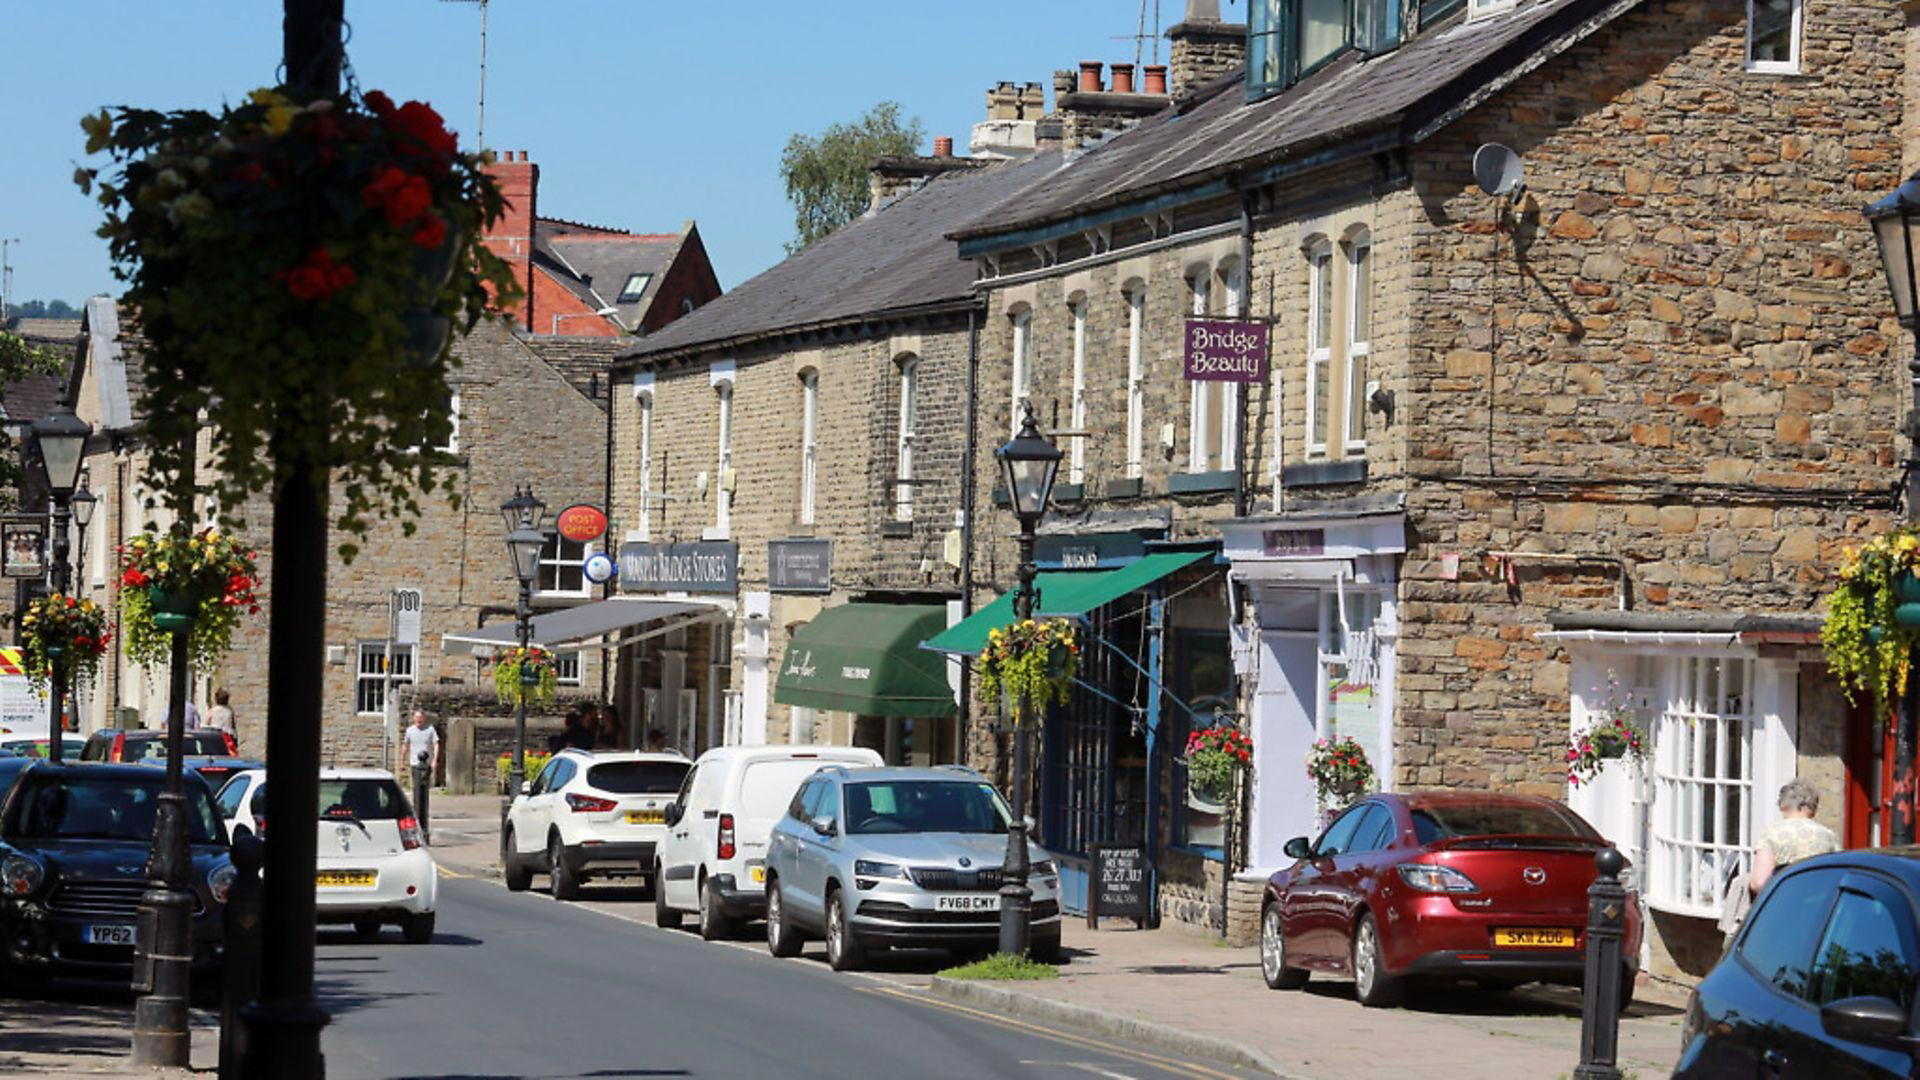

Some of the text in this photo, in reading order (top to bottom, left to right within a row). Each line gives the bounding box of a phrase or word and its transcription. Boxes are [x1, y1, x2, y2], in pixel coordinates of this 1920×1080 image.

[1192, 327, 1259, 354] Bridge
[1191, 351, 1259, 378] Beauty
[568, 514, 596, 524] POST
[563, 525, 599, 536] OFFICE
[693, 551, 728, 582] STORES
[940, 896, 997, 909] FV68 CMY
[92, 926, 132, 943] YP62
